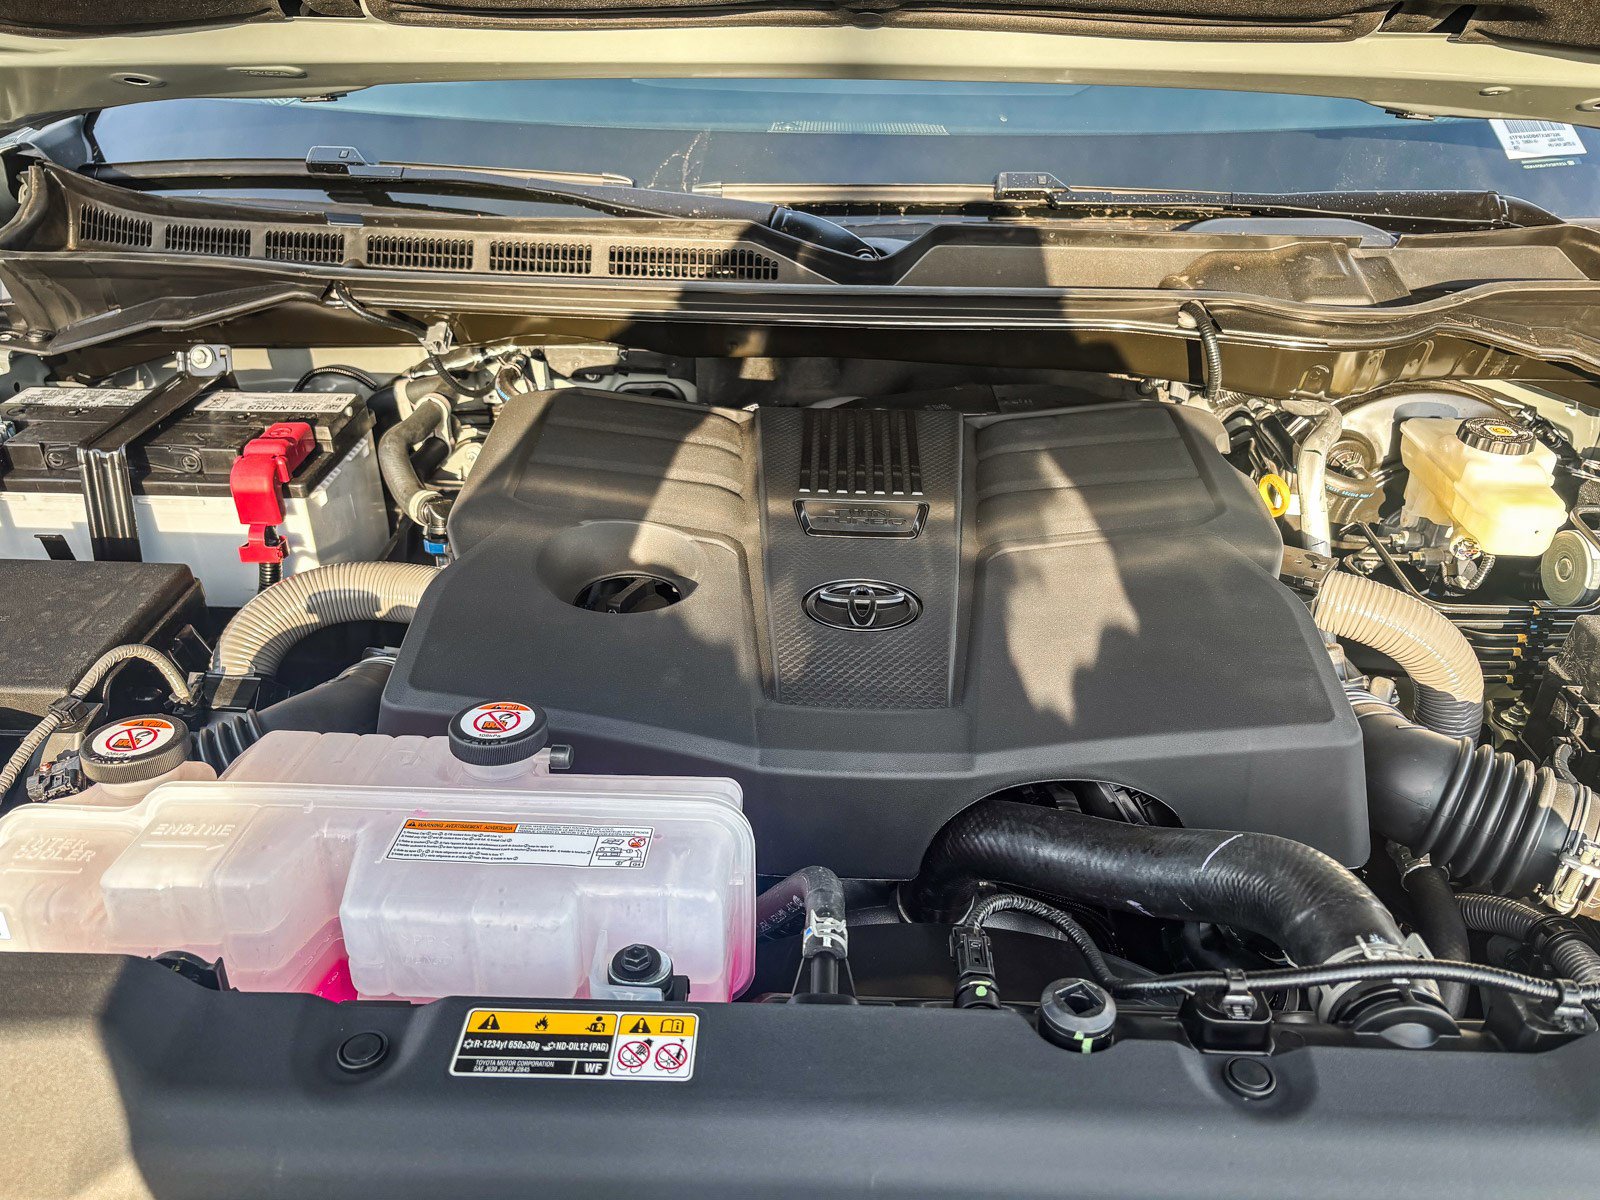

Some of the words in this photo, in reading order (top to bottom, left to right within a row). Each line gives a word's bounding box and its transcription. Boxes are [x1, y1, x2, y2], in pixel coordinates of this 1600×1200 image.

[150, 823, 236, 836] ENGINE
[473, 1039, 508, 1050] R-1234yf
[508, 1040, 540, 1051] 650±30g
[589, 1043, 609, 1053] (PAG)
[517, 1060, 555, 1068] CORPORATION
[584, 1063, 603, 1073] WF
